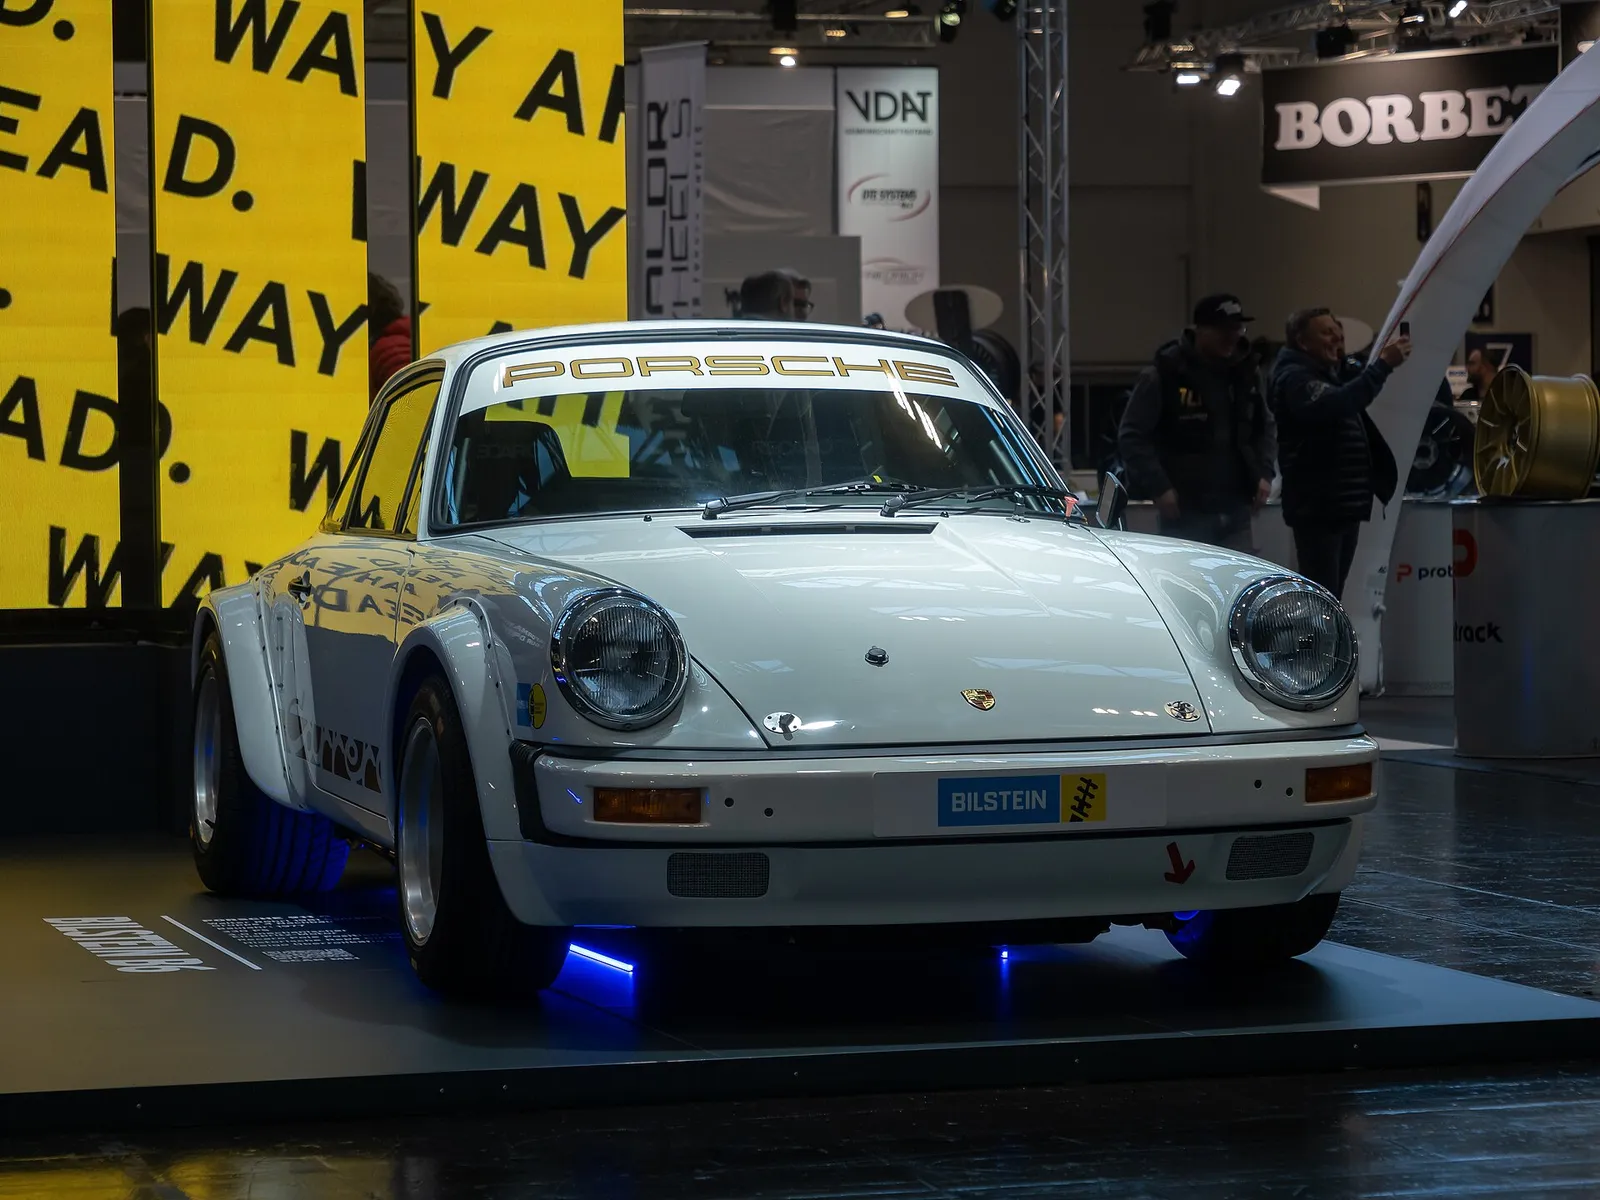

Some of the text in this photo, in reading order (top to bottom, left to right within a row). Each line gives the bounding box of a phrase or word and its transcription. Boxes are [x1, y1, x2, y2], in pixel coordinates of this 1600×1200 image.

[845, 90, 932, 122] VDAT
[502, 354, 959, 388] PORSCHE
[951, 789, 1047, 812] BILSTEIN
